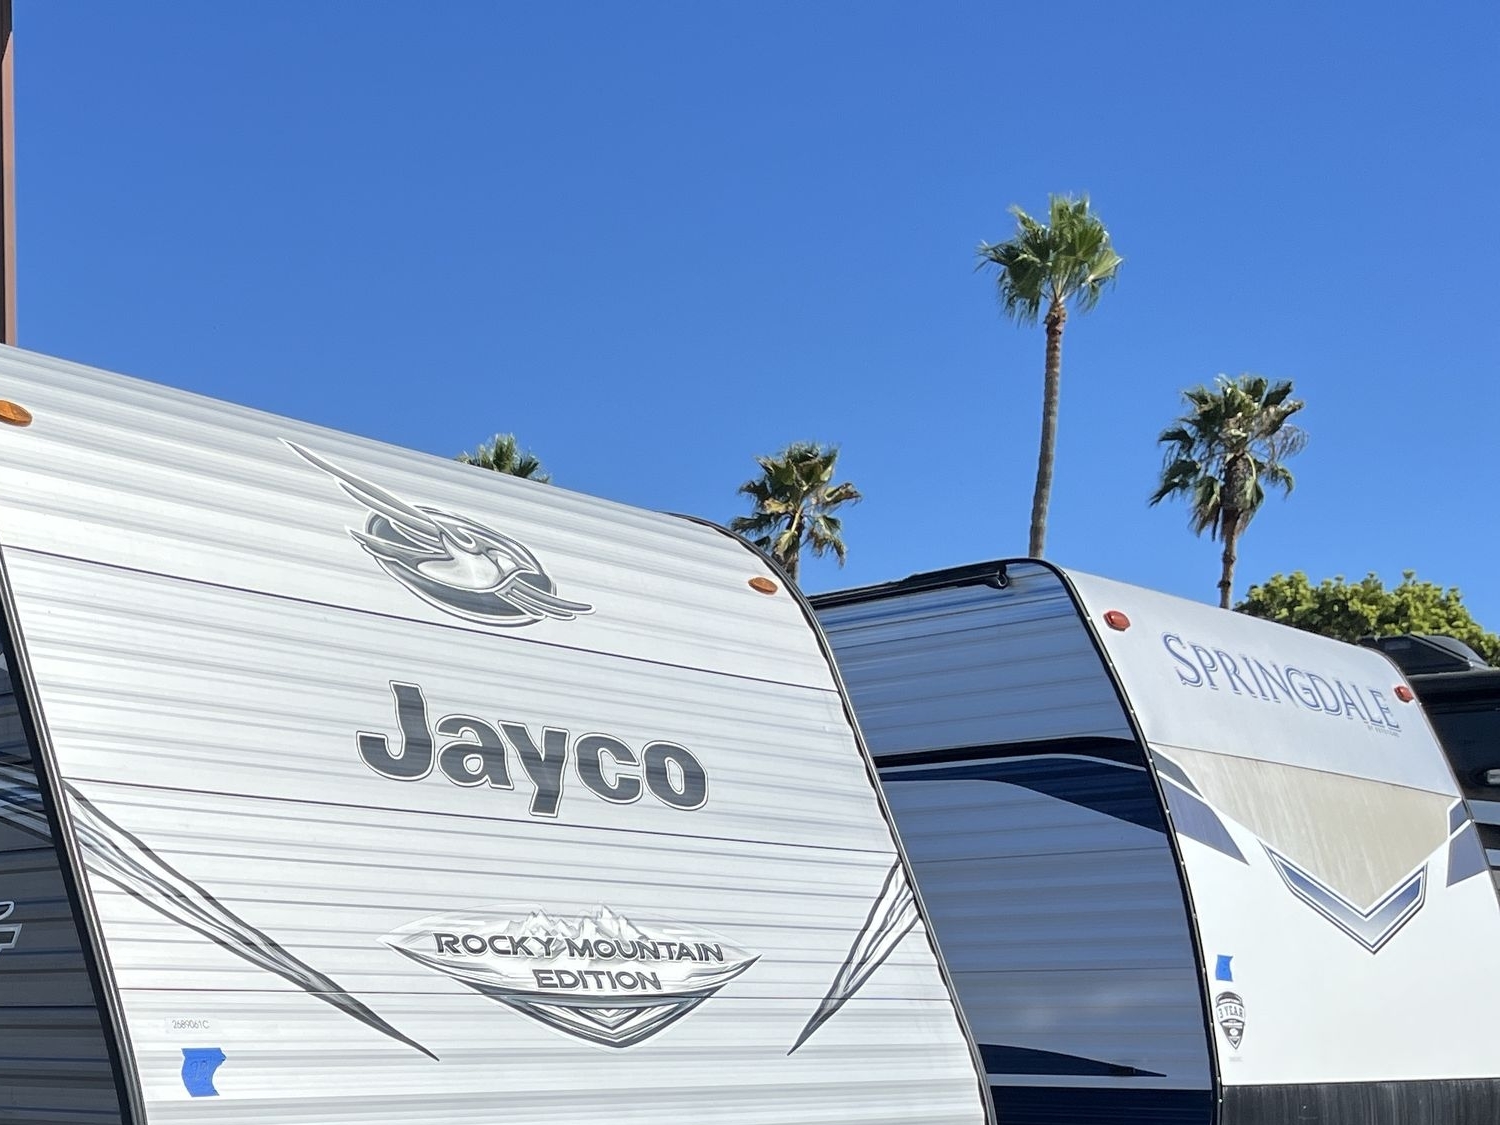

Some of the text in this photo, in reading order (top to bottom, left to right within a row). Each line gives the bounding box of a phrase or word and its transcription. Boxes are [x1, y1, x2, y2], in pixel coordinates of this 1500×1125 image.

[1162, 632, 1401, 733] SPRINGDALE
[356, 680, 708, 817] Jayco
[434, 932, 725, 962] ROCKY MOUNTAIN
[532, 968, 663, 991] EDITION
